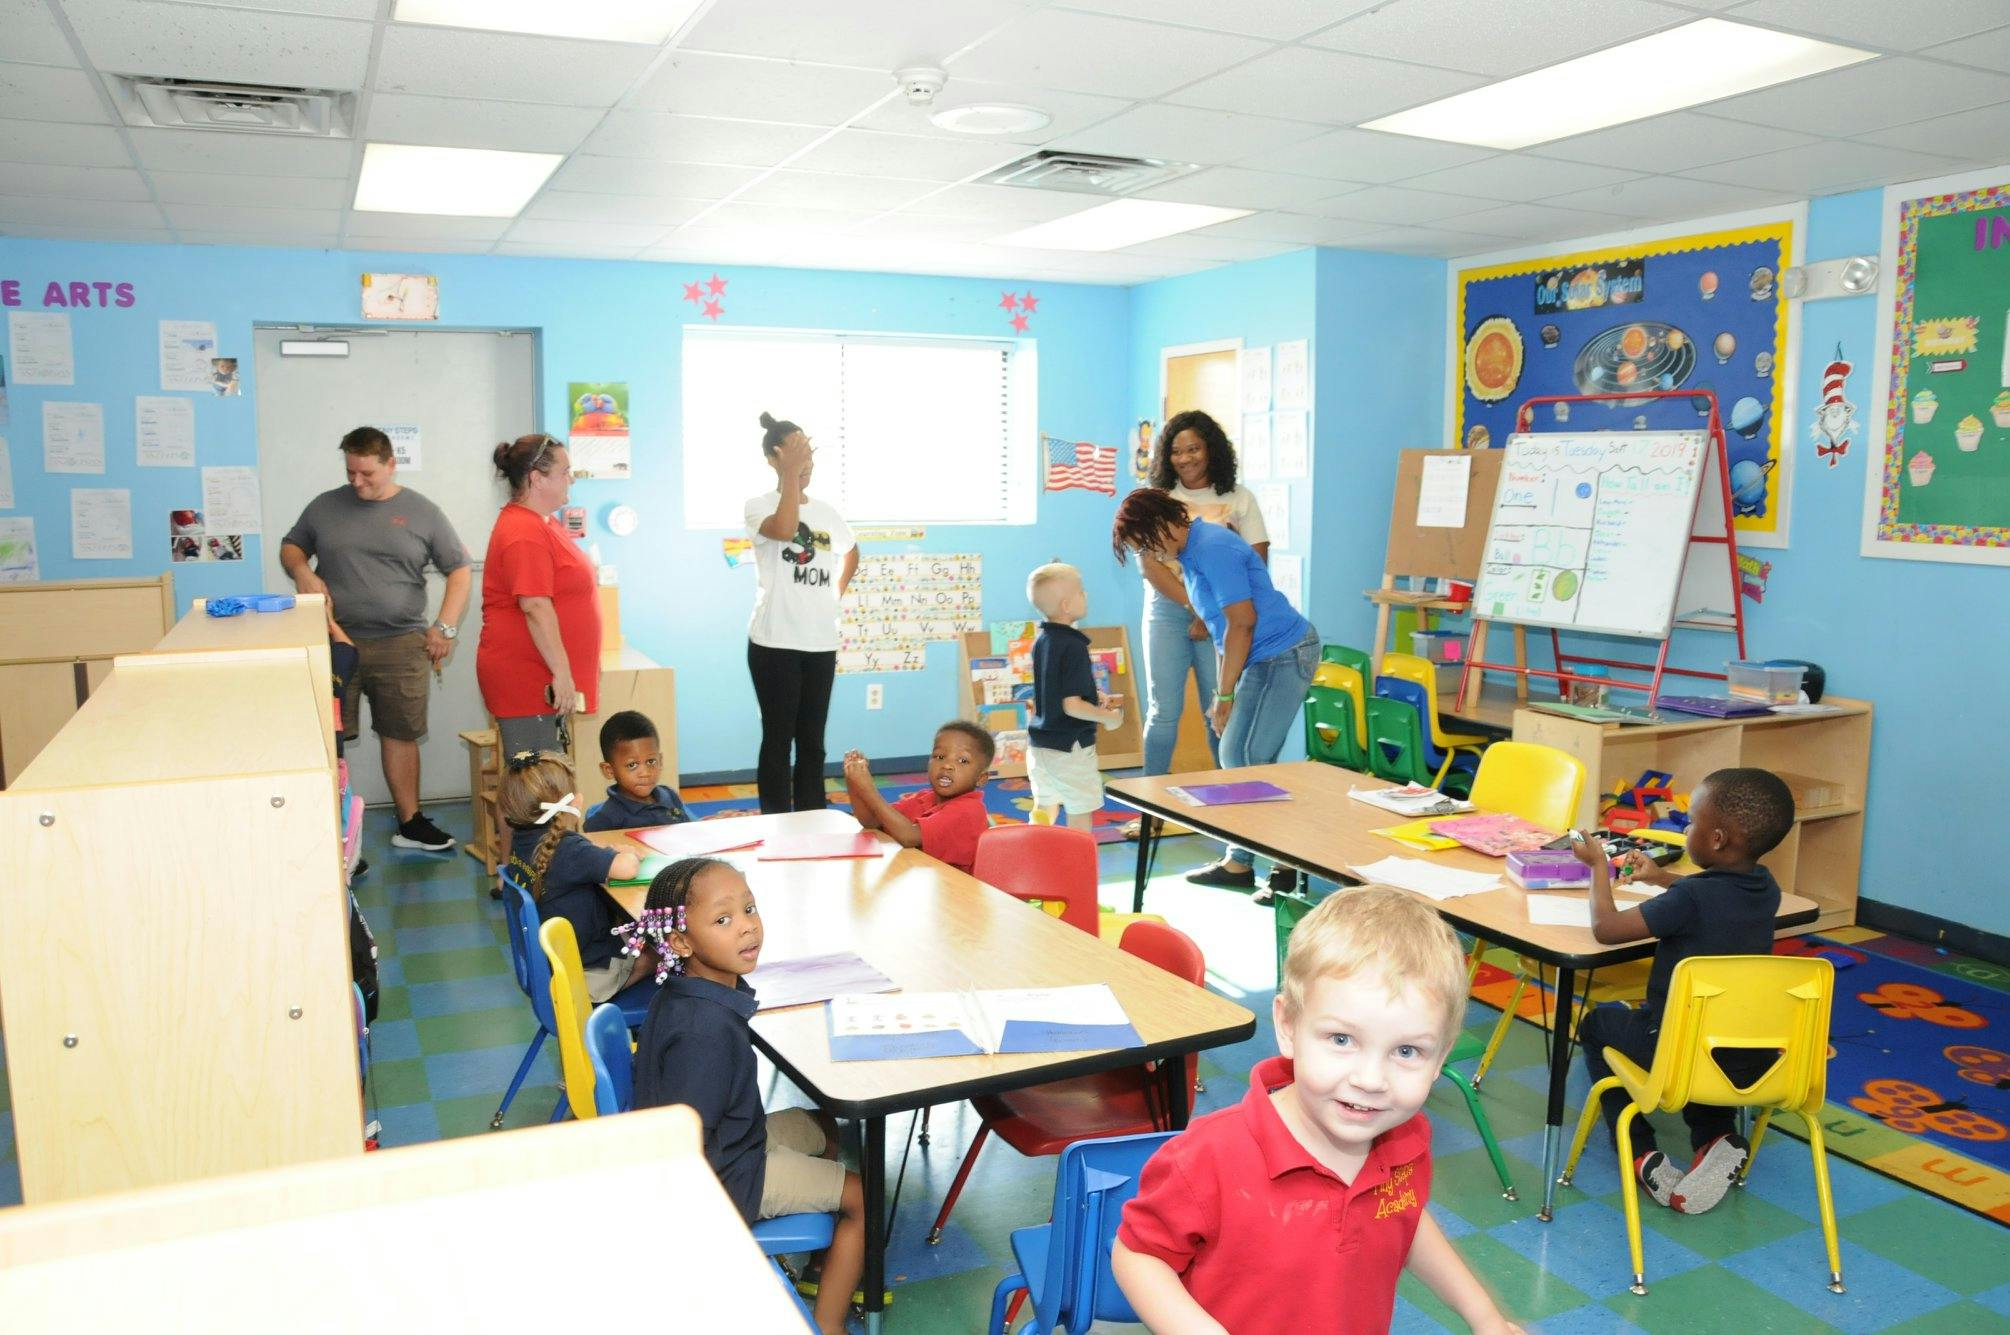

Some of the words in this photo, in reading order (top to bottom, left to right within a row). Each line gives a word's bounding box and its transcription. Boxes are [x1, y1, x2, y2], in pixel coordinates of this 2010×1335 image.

[43, 281, 136, 308] ARTS
[1537, 284, 1558, 305] Our
[1597, 271, 1643, 303] System
[1560, 439, 1607, 462] Tuesday
[1503, 487, 1535, 504] One
[793, 565, 830, 587] MOM
[881, 563, 894, 576] Ee
[931, 562, 950, 578] Gg
[960, 563, 976, 576] Hh
[936, 592, 953, 605] Oo
[903, 651, 920, 664] Zz
[1374, 1187, 1419, 1220] Academy
